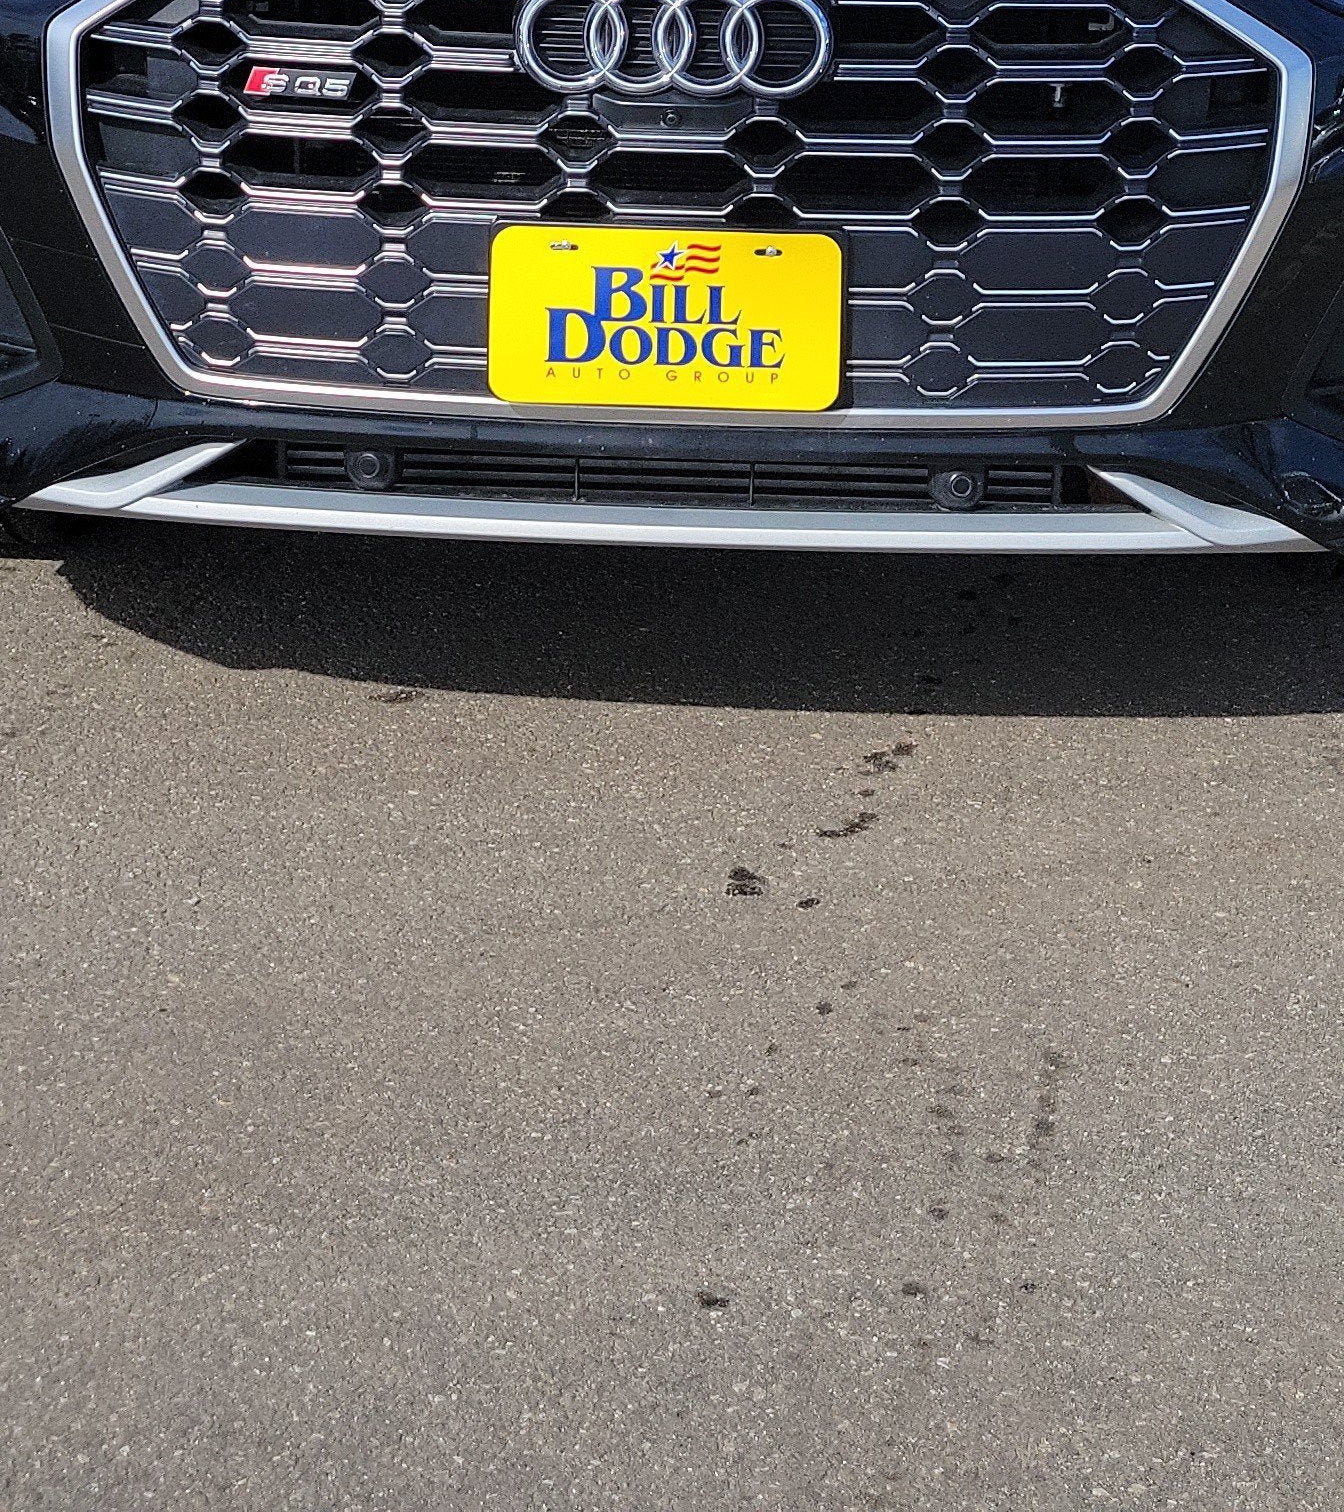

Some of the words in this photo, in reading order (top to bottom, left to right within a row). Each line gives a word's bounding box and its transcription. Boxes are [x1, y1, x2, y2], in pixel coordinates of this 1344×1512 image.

[260, 72, 351, 98] SQ5
[591, 265, 743, 326] BILL
[544, 306, 786, 370] DODGE
[545, 366, 631, 381] AUTO
[665, 369, 780, 385] GROUP
